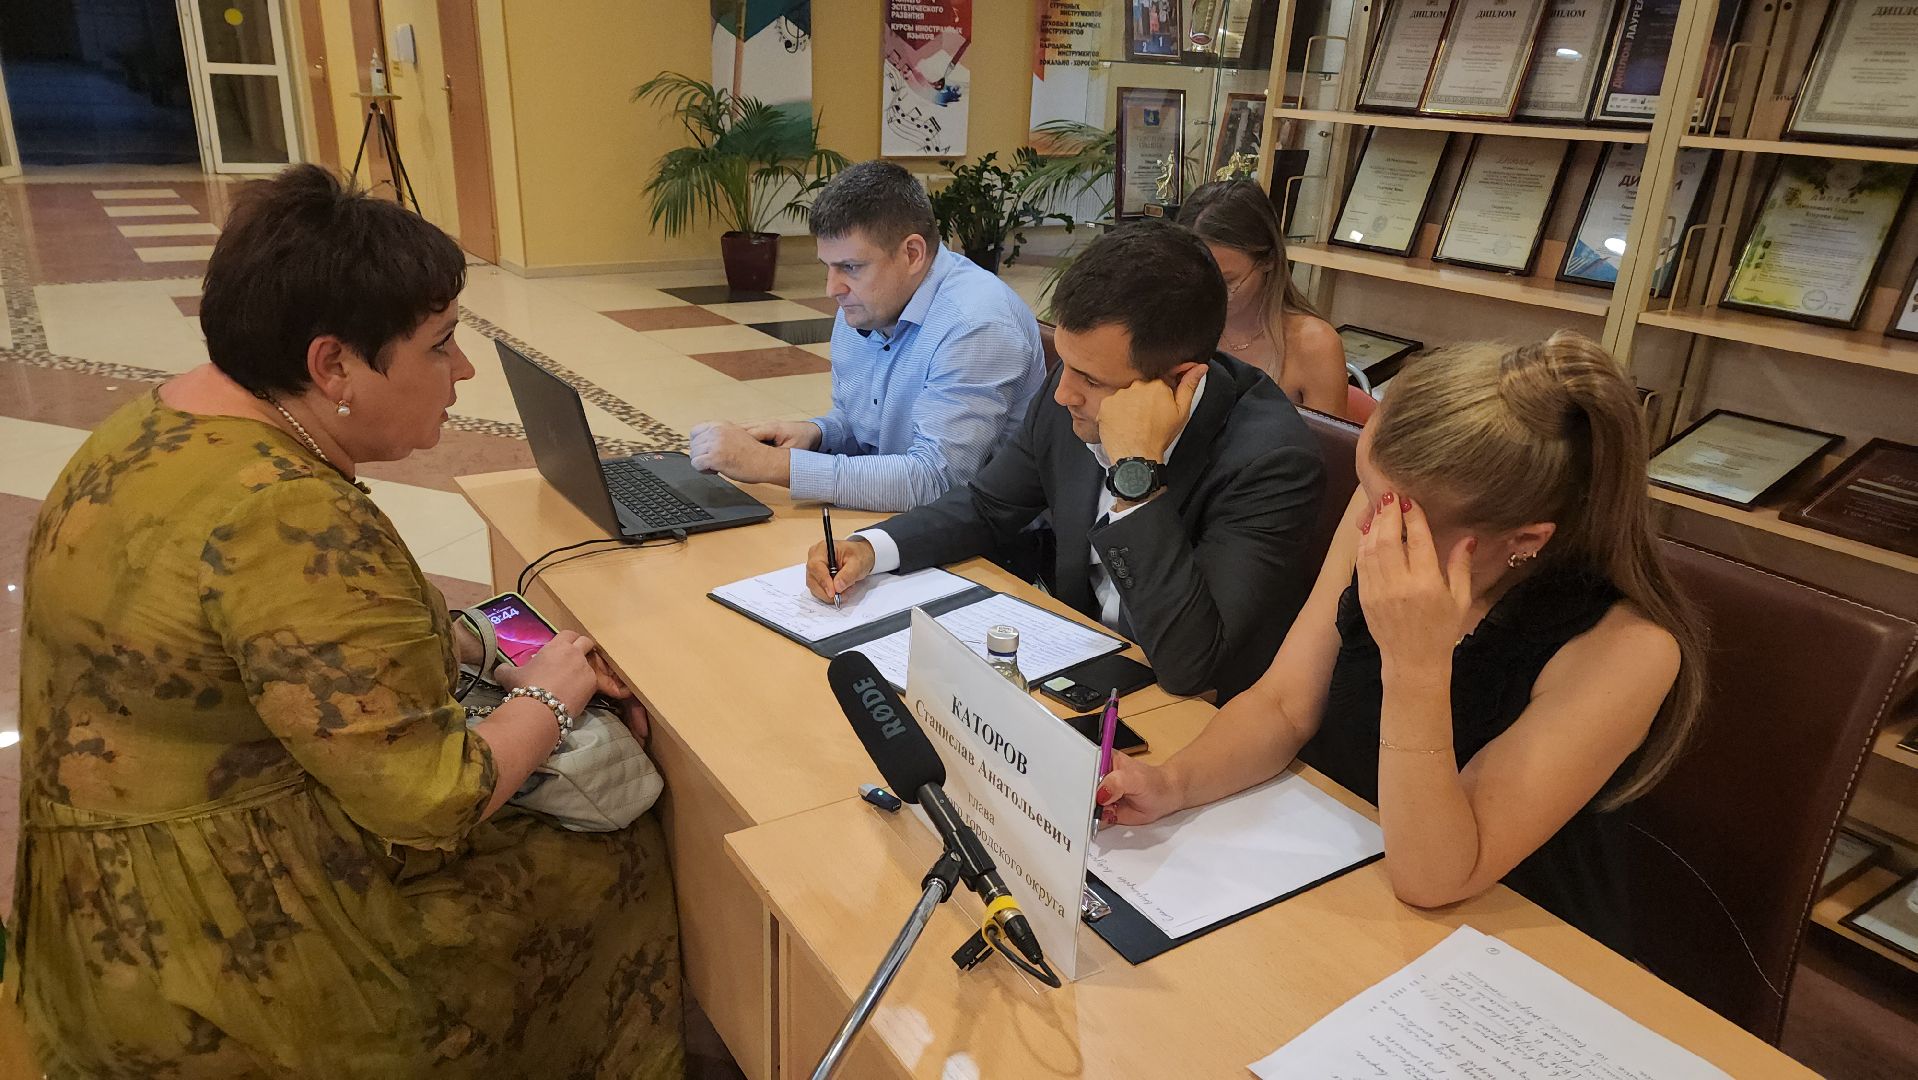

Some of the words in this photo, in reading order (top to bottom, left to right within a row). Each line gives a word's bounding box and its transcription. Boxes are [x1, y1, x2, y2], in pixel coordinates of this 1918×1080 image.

[891, 3, 944, 13] ЭСТЕТИЧЕСКОГО
[891, 11, 925, 20] РАЗВИТИЯ
[1410, 10, 1447, 18] ДИПЛОМ
[1475, 9, 1517, 19] ДИПЛОМ
[1549, 9, 1586, 18] ИПЛОМ
[890, 23, 914, 31] КУРСЫ
[915, 24, 963, 34] ИНОСТРАННЫХ
[906, 32, 935, 40] ЯЗЫКОВ
[852, 677, 907, 739] RØDE
[951, 693, 1028, 775] КАТОРОВ
[915, 700, 975, 766] Станислав
[978, 759, 1072, 854] Анатольевич
[968, 792, 996, 826] глава
[966, 815, 1023, 877] городского
[1026, 873, 1066, 918] округа
